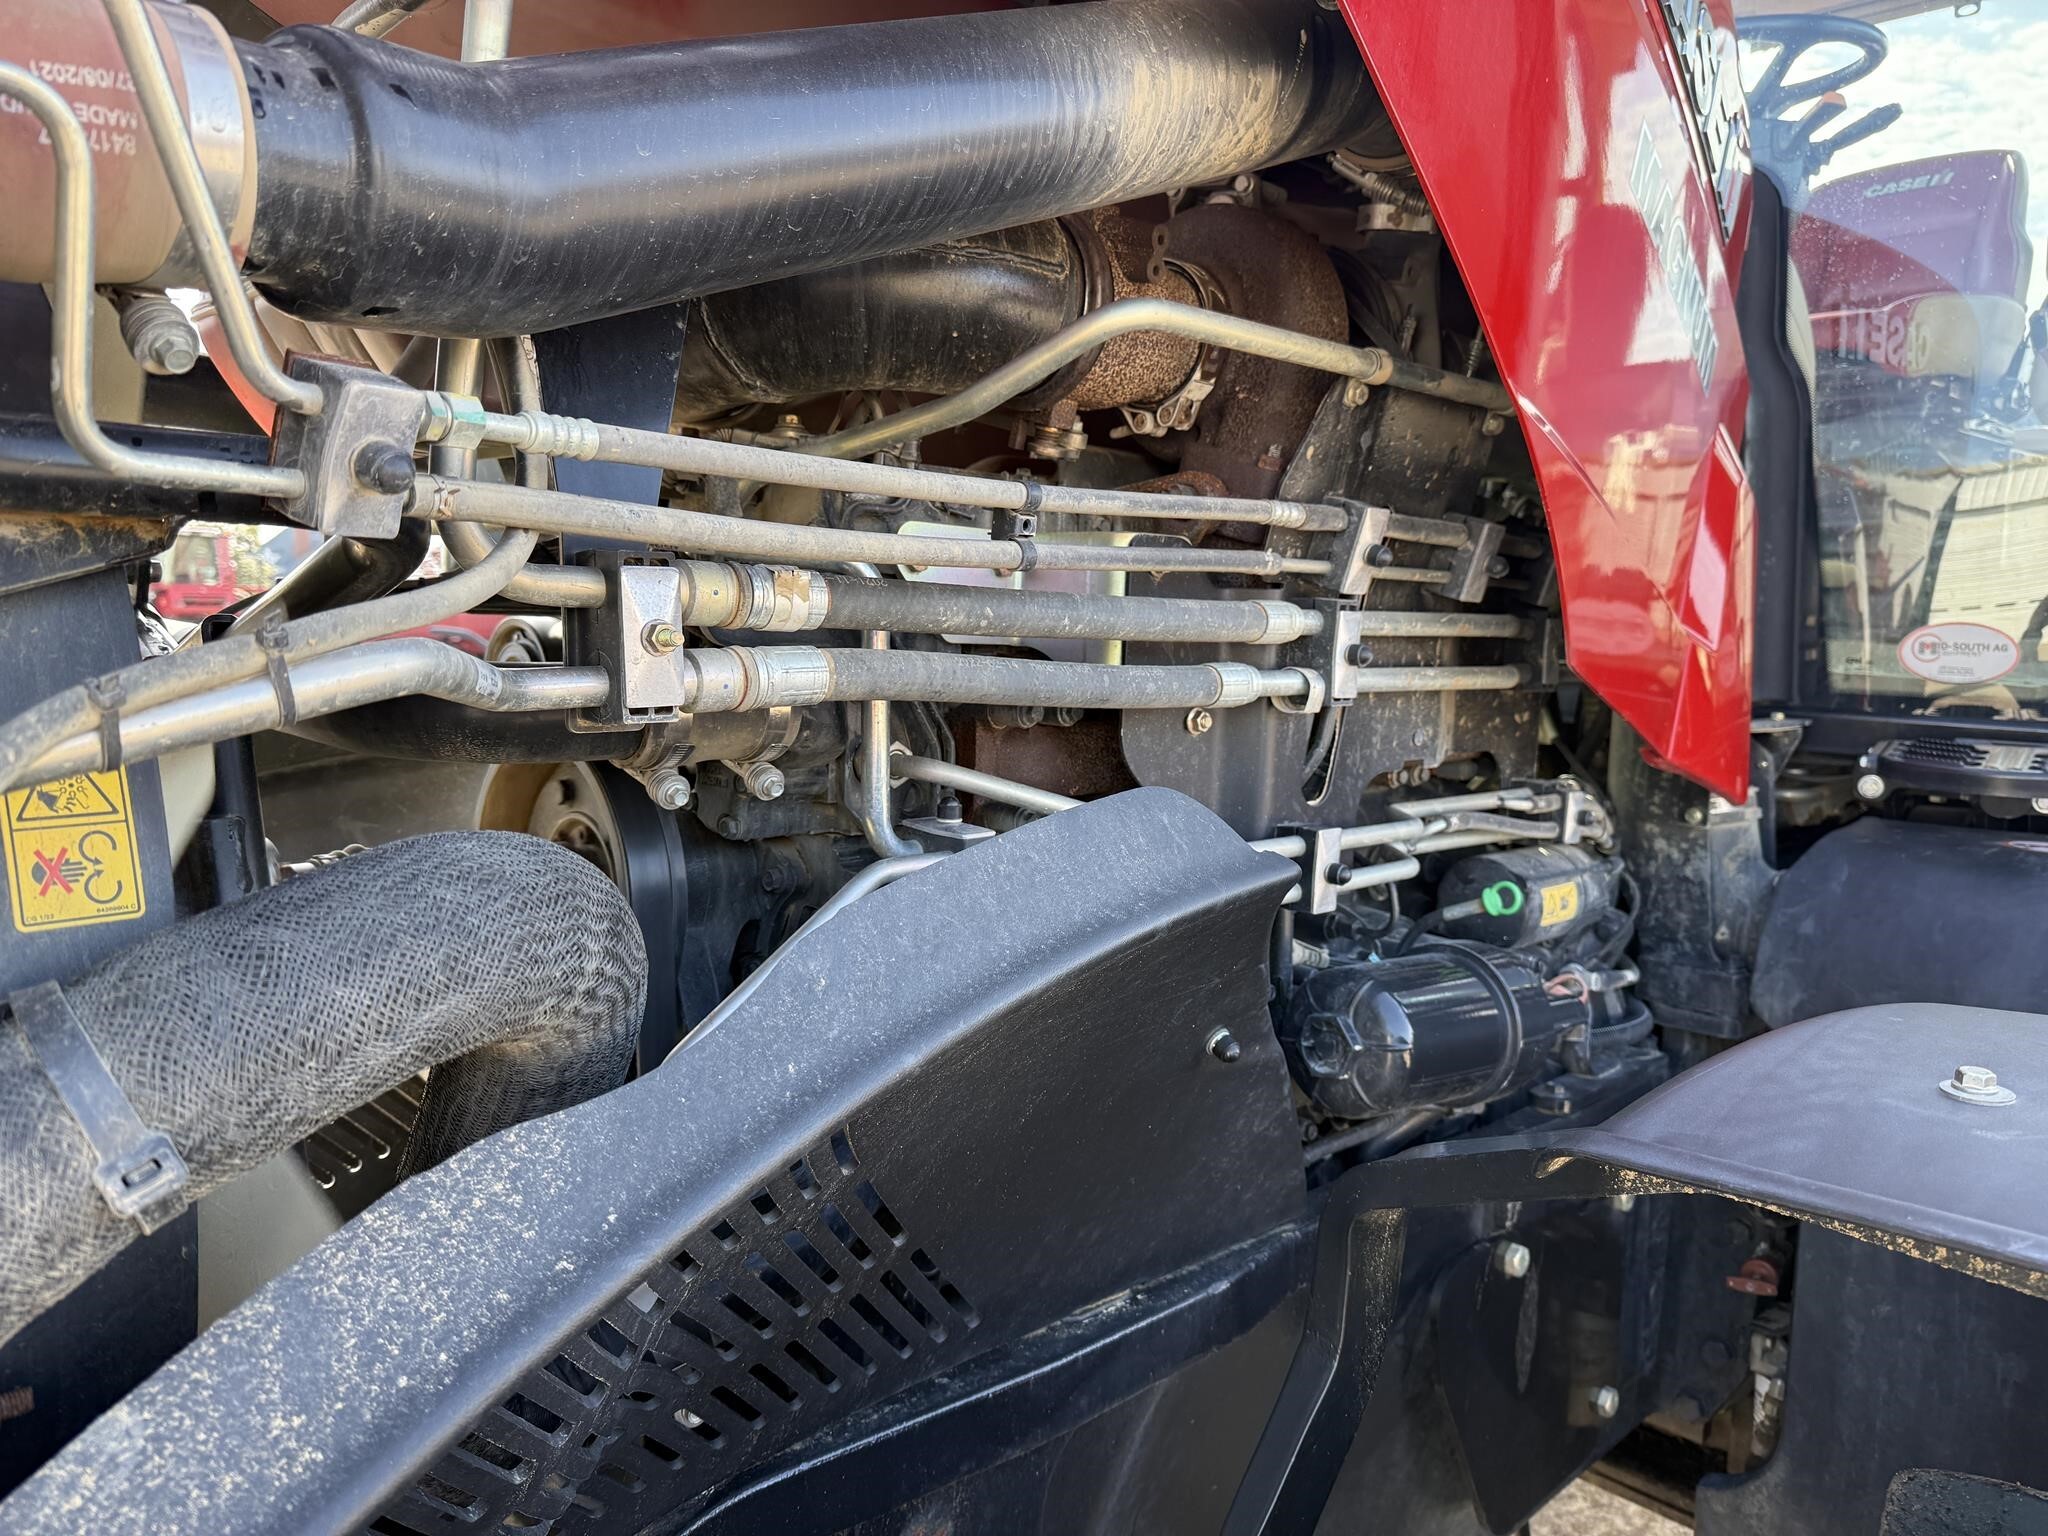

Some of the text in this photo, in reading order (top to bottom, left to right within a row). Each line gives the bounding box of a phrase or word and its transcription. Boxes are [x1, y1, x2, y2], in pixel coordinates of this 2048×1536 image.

[72, 101, 138, 130] MADE
[1629, 116, 1719, 398] MAGNUM
[1992, 643, 2009, 652] AG
